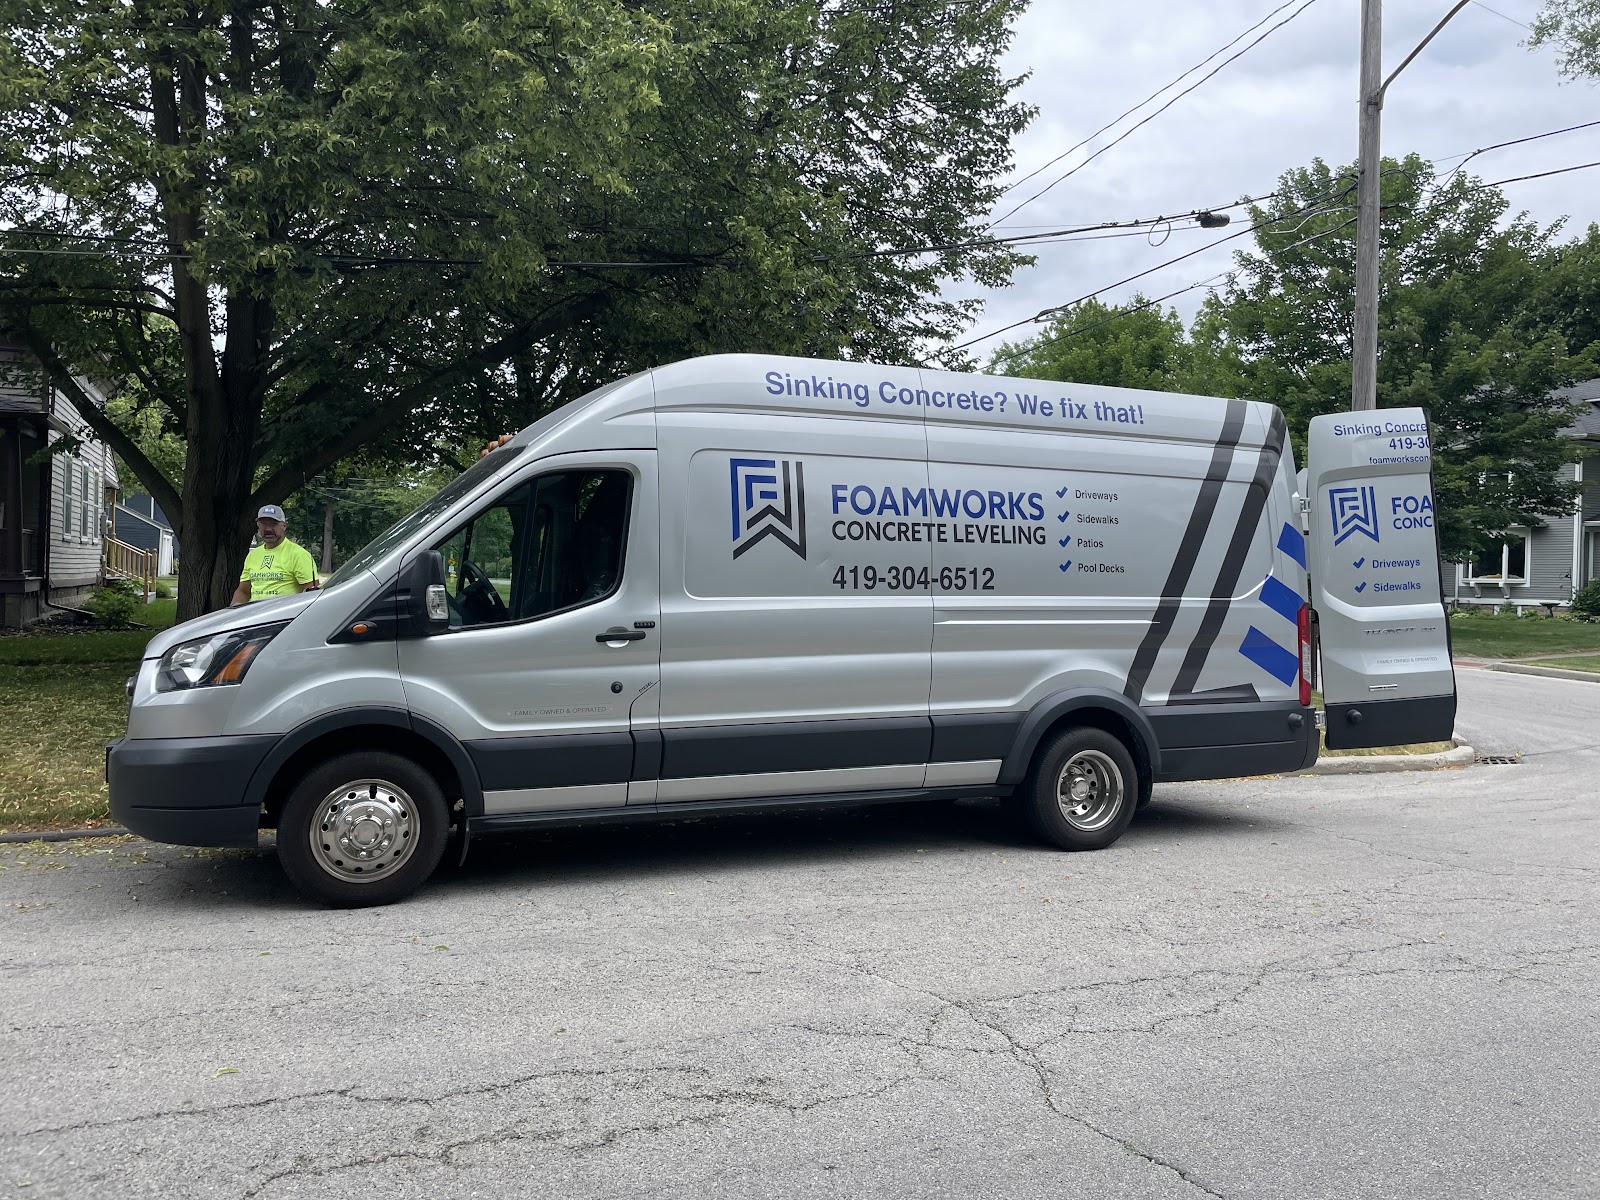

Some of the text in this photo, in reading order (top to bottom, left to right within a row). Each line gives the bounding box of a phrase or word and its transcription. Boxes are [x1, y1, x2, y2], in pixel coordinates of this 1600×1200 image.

[765, 371, 1144, 425] Sinking Concrete? We fix that!
[1334, 422, 1428, 437] Sinking Concre
[1369, 455, 1430, 464] foamworkscon
[1075, 489, 1119, 502] Driveways
[831, 484, 1045, 521] FOAMWORKS
[1391, 495, 1433, 515] FOA
[1076, 513, 1119, 524] Sidewalks
[1393, 516, 1432, 530] CONC
[832, 520, 1046, 545] CONCRETE LEVELING
[1077, 538, 1104, 548] Patios
[1078, 563, 1125, 573] Pool Decks
[1372, 559, 1421, 569] Driveways
[832, 565, 995, 590] 419-304-6512
[1373, 582, 1422, 592] Sidewalks
[539, 708, 565, 716] OWNED
[572, 706, 607, 714] OPERATED
